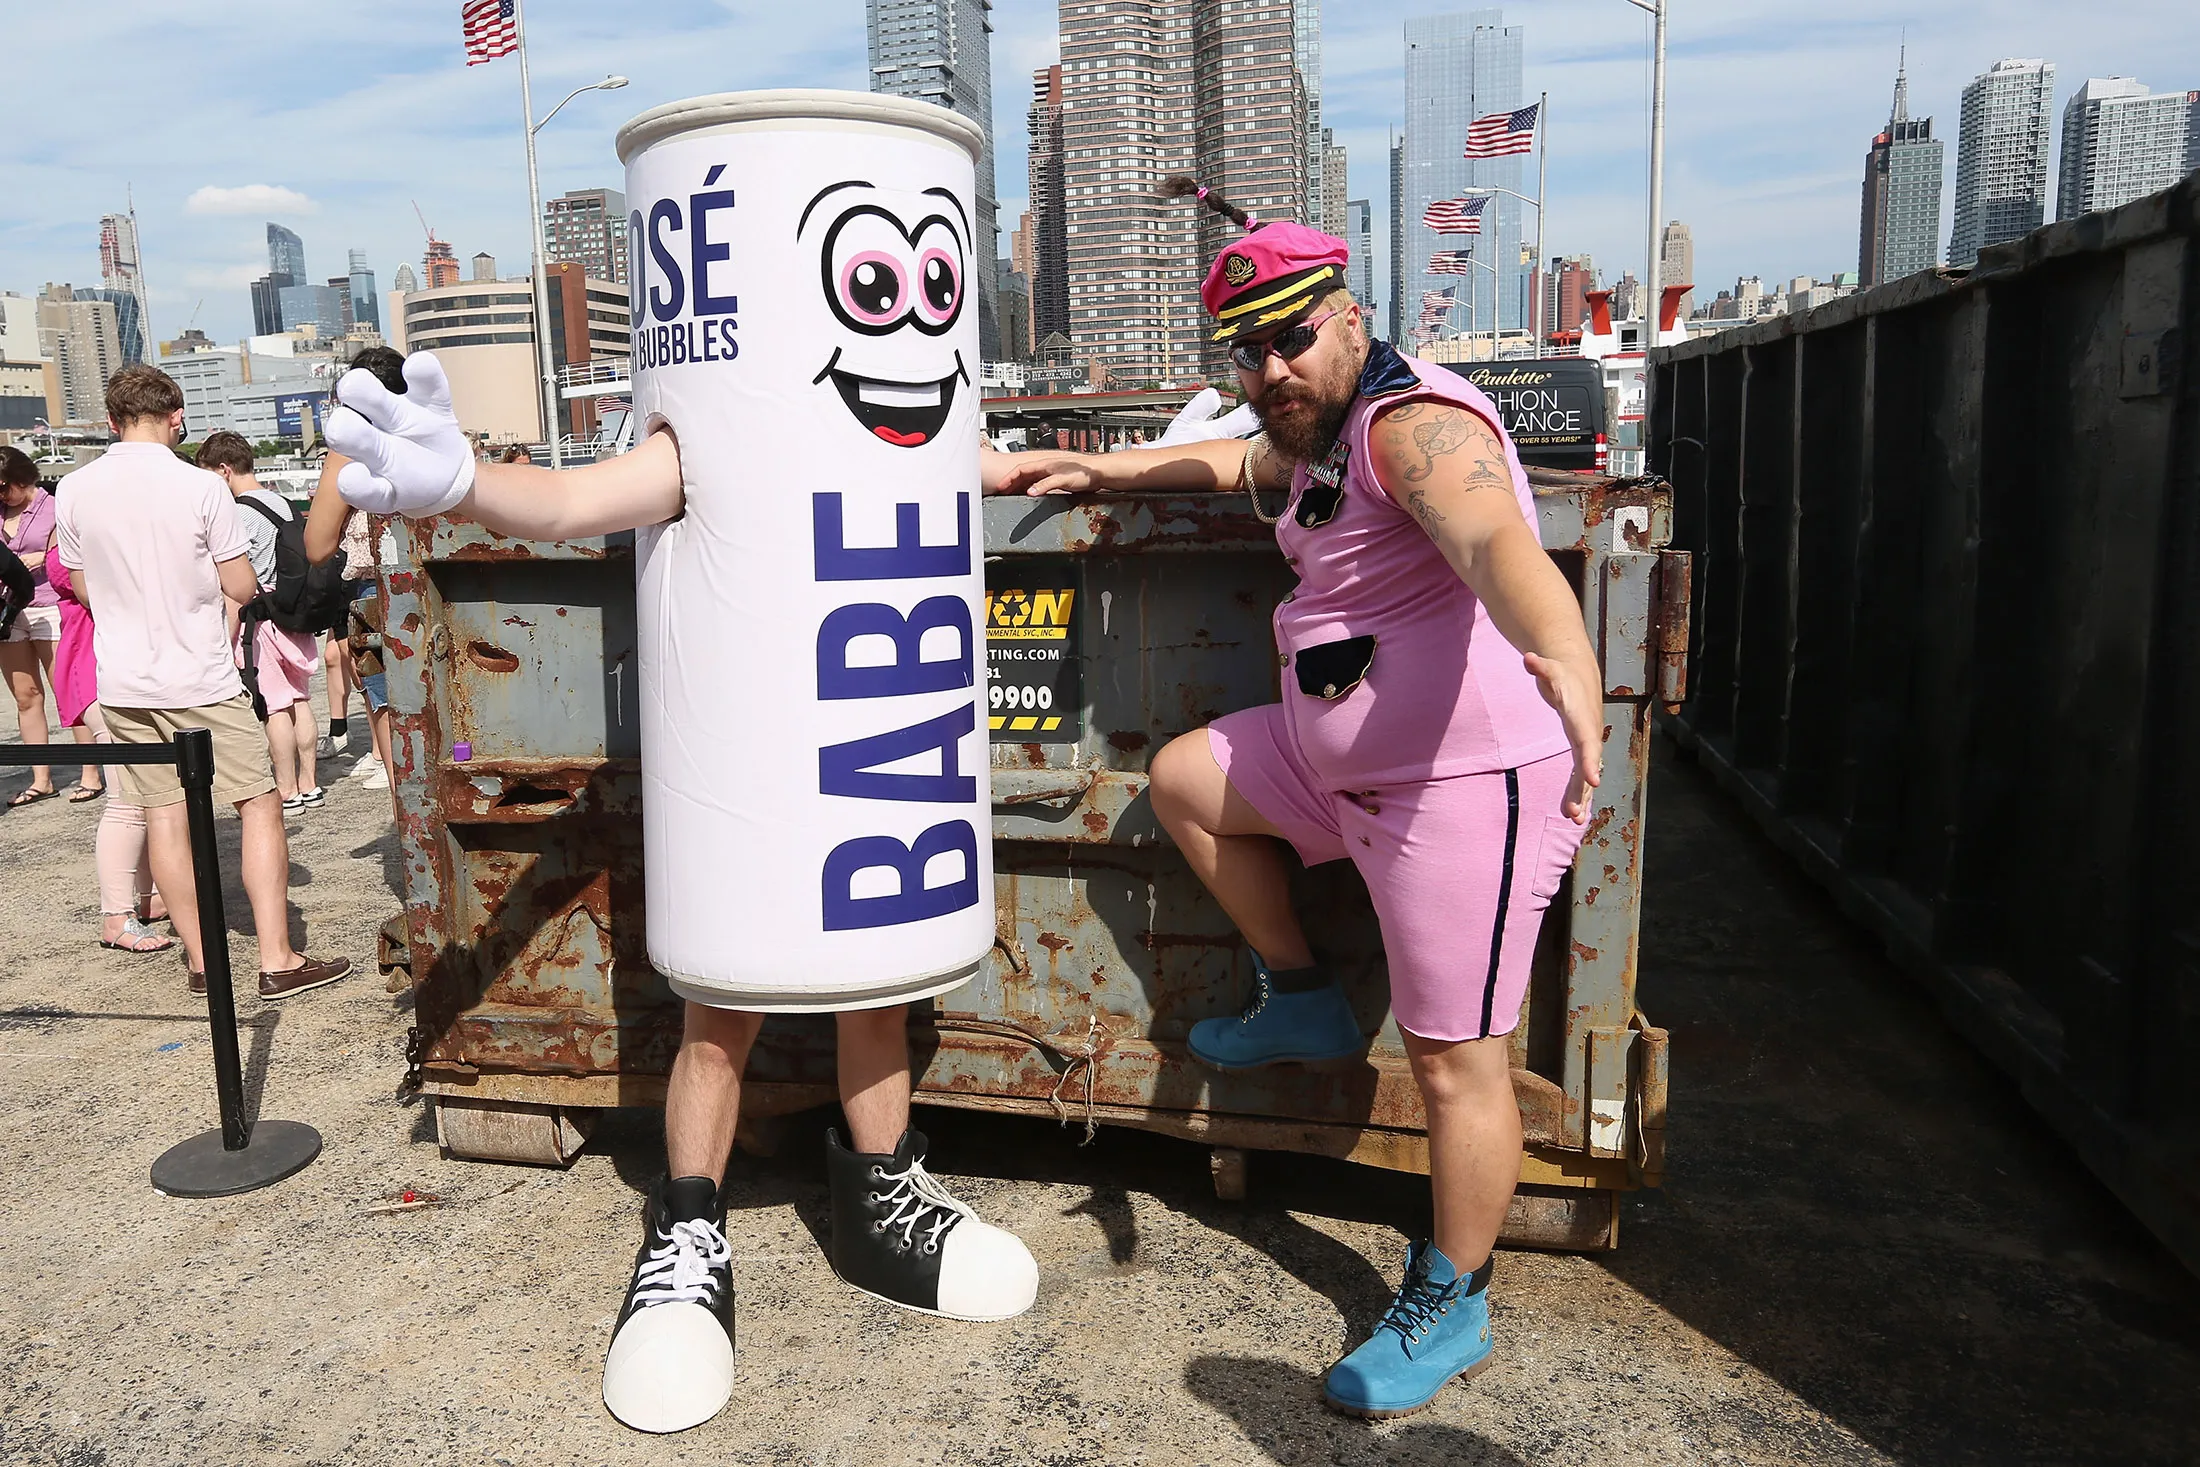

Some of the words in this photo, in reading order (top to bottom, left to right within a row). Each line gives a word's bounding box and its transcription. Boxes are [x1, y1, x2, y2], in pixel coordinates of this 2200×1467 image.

[639, 318, 739, 371] BUBBLES
[1469, 368, 1546, 386] Paulette
[1498, 410, 1581, 433] LANCE
[1519, 436, 1540, 444] OVER
[1040, 629, 1055, 637] INC.
[989, 685, 1053, 710] 9900
[812, 491, 979, 932] BABE
